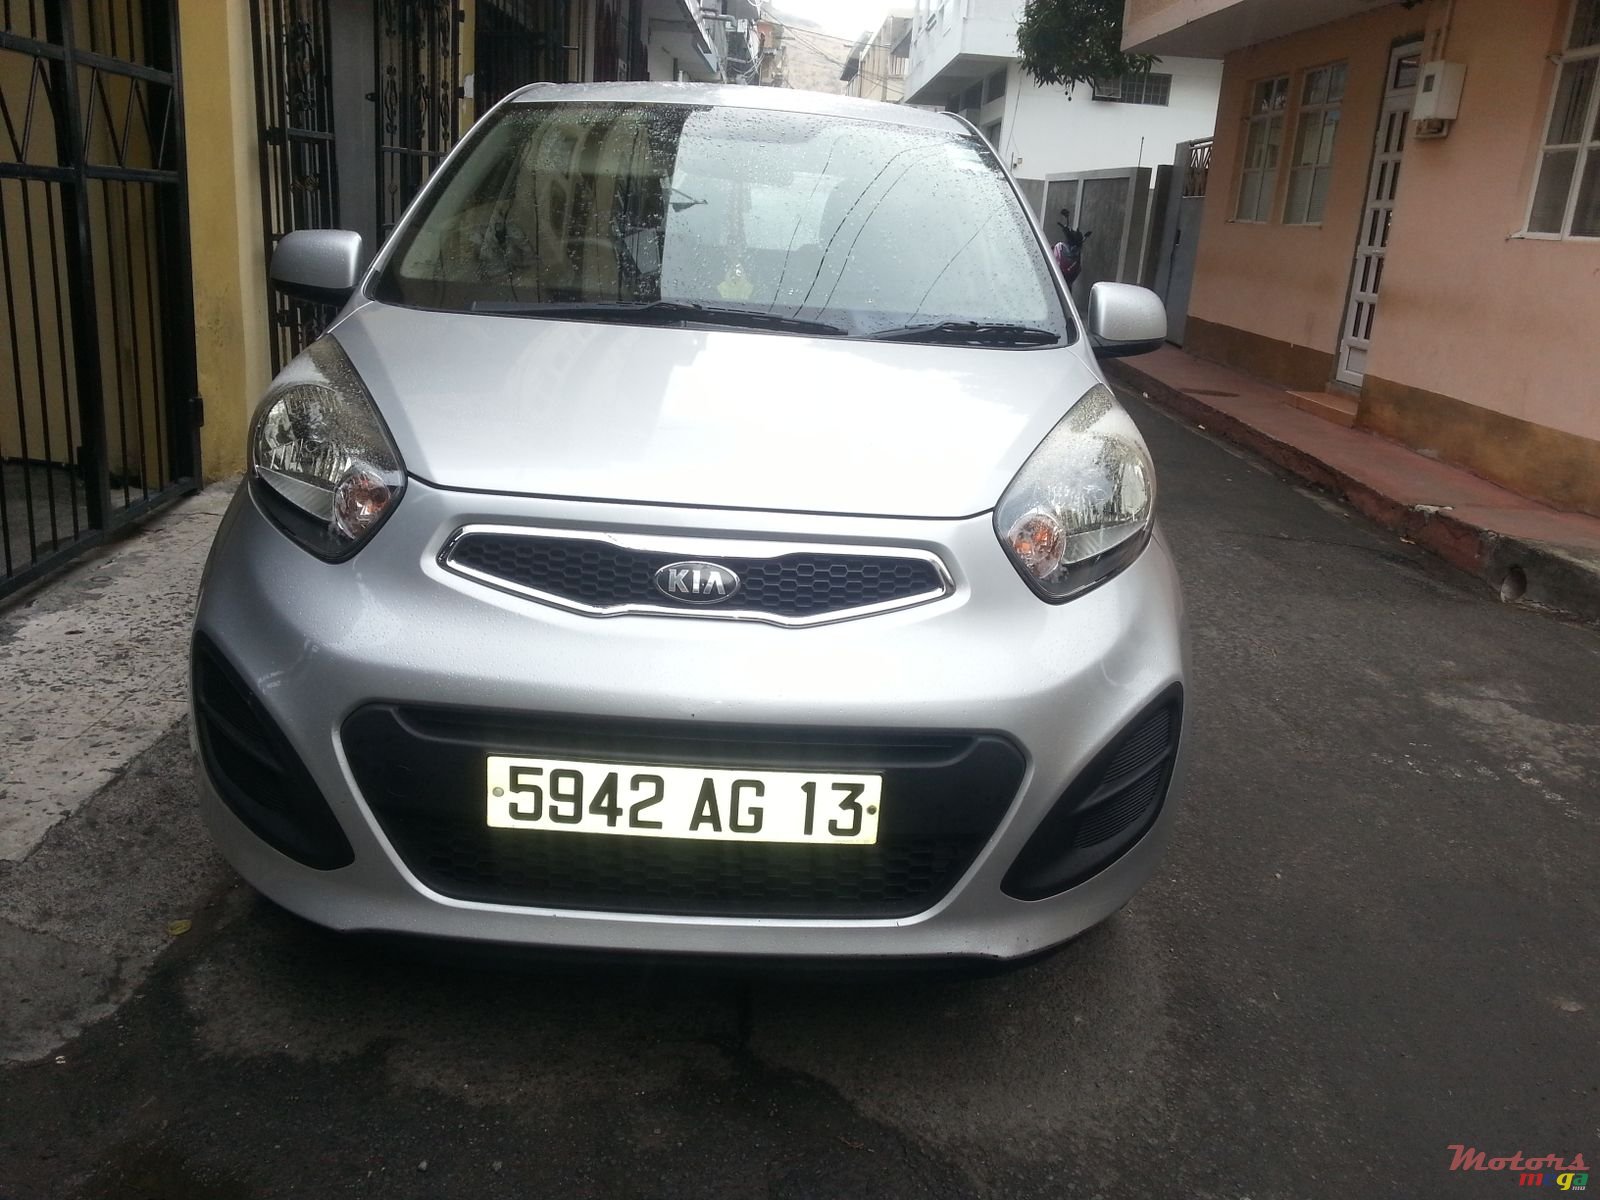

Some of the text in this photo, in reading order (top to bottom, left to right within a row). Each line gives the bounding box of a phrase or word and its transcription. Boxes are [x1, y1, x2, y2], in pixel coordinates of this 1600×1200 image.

[668, 568, 726, 595] KIA
[509, 765, 865, 837] 5942 AG 13
